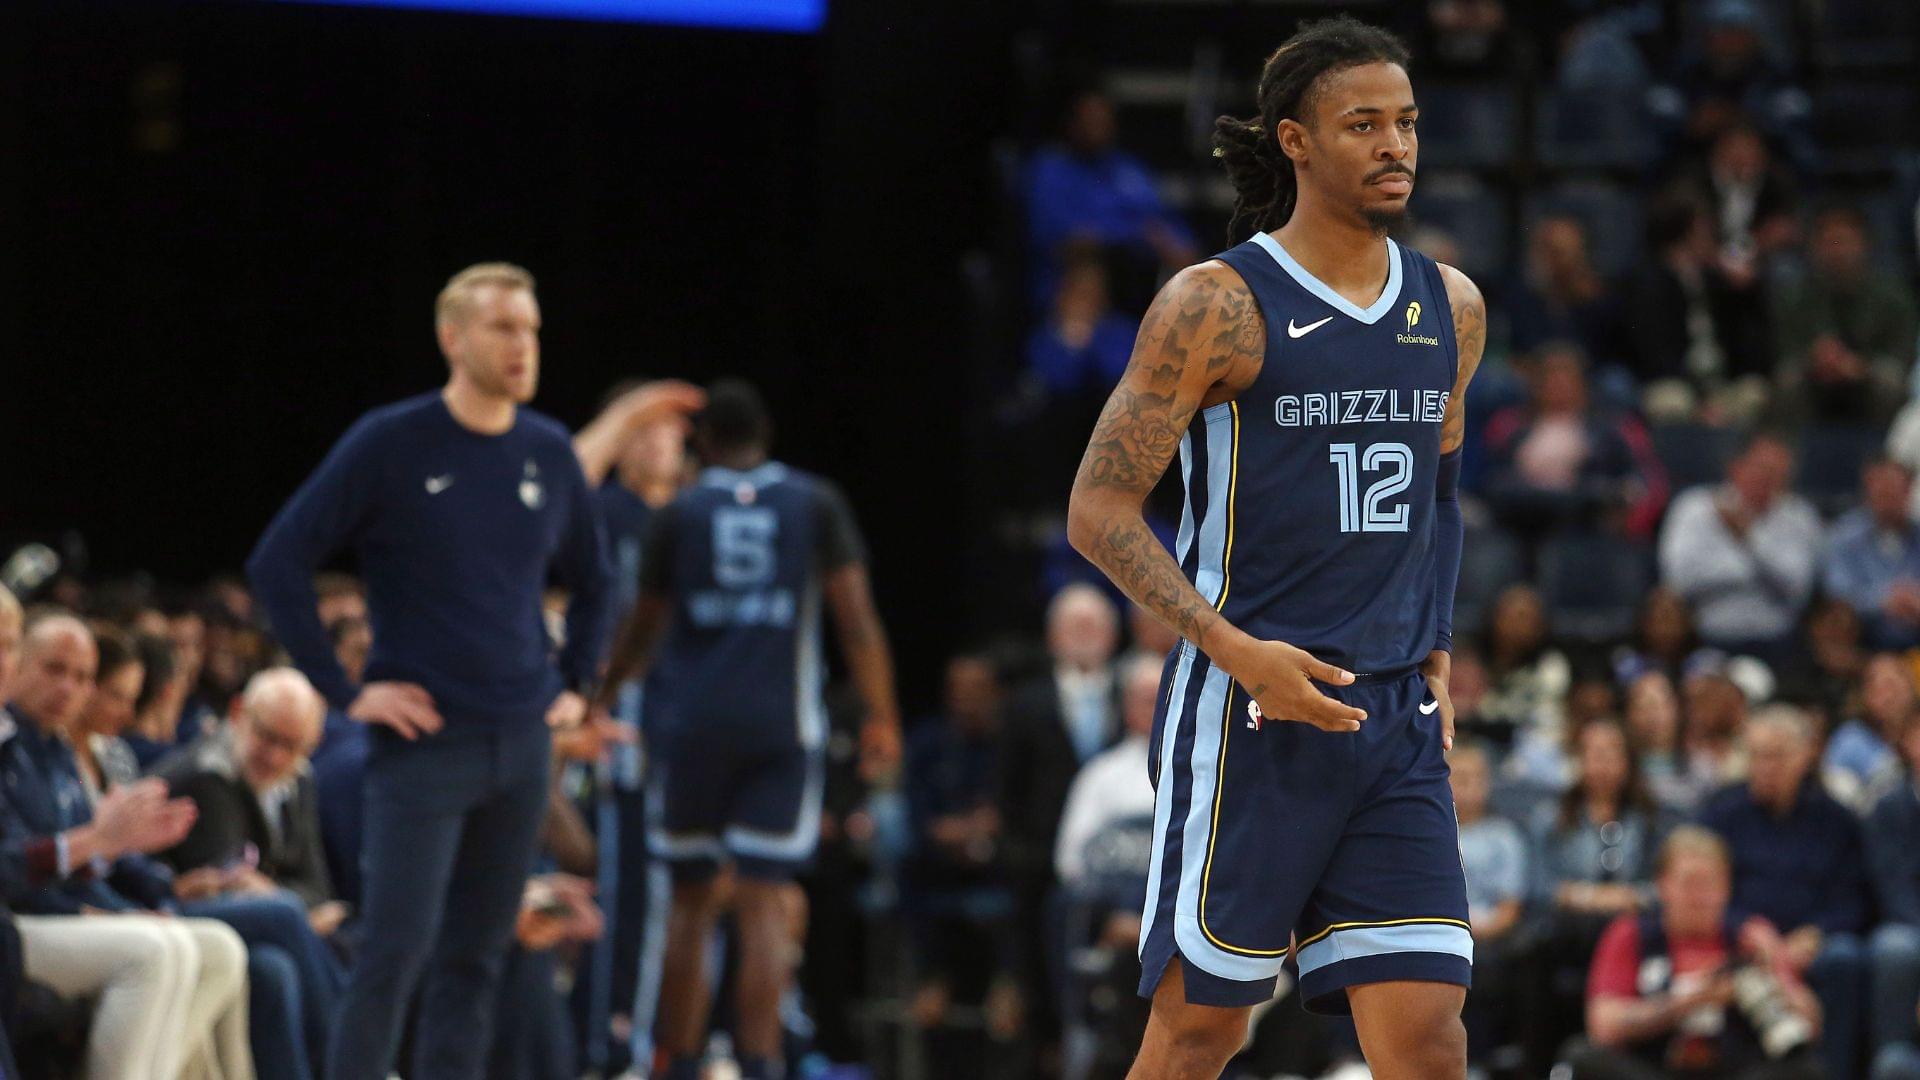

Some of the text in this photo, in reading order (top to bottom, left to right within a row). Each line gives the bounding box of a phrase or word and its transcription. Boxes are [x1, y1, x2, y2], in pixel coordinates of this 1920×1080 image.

[1396, 333, 1438, 346] Robinhood
[1275, 389, 1450, 426] GRIZZLIES
[1329, 442, 1414, 532] 12
[711, 507, 778, 588] 5
